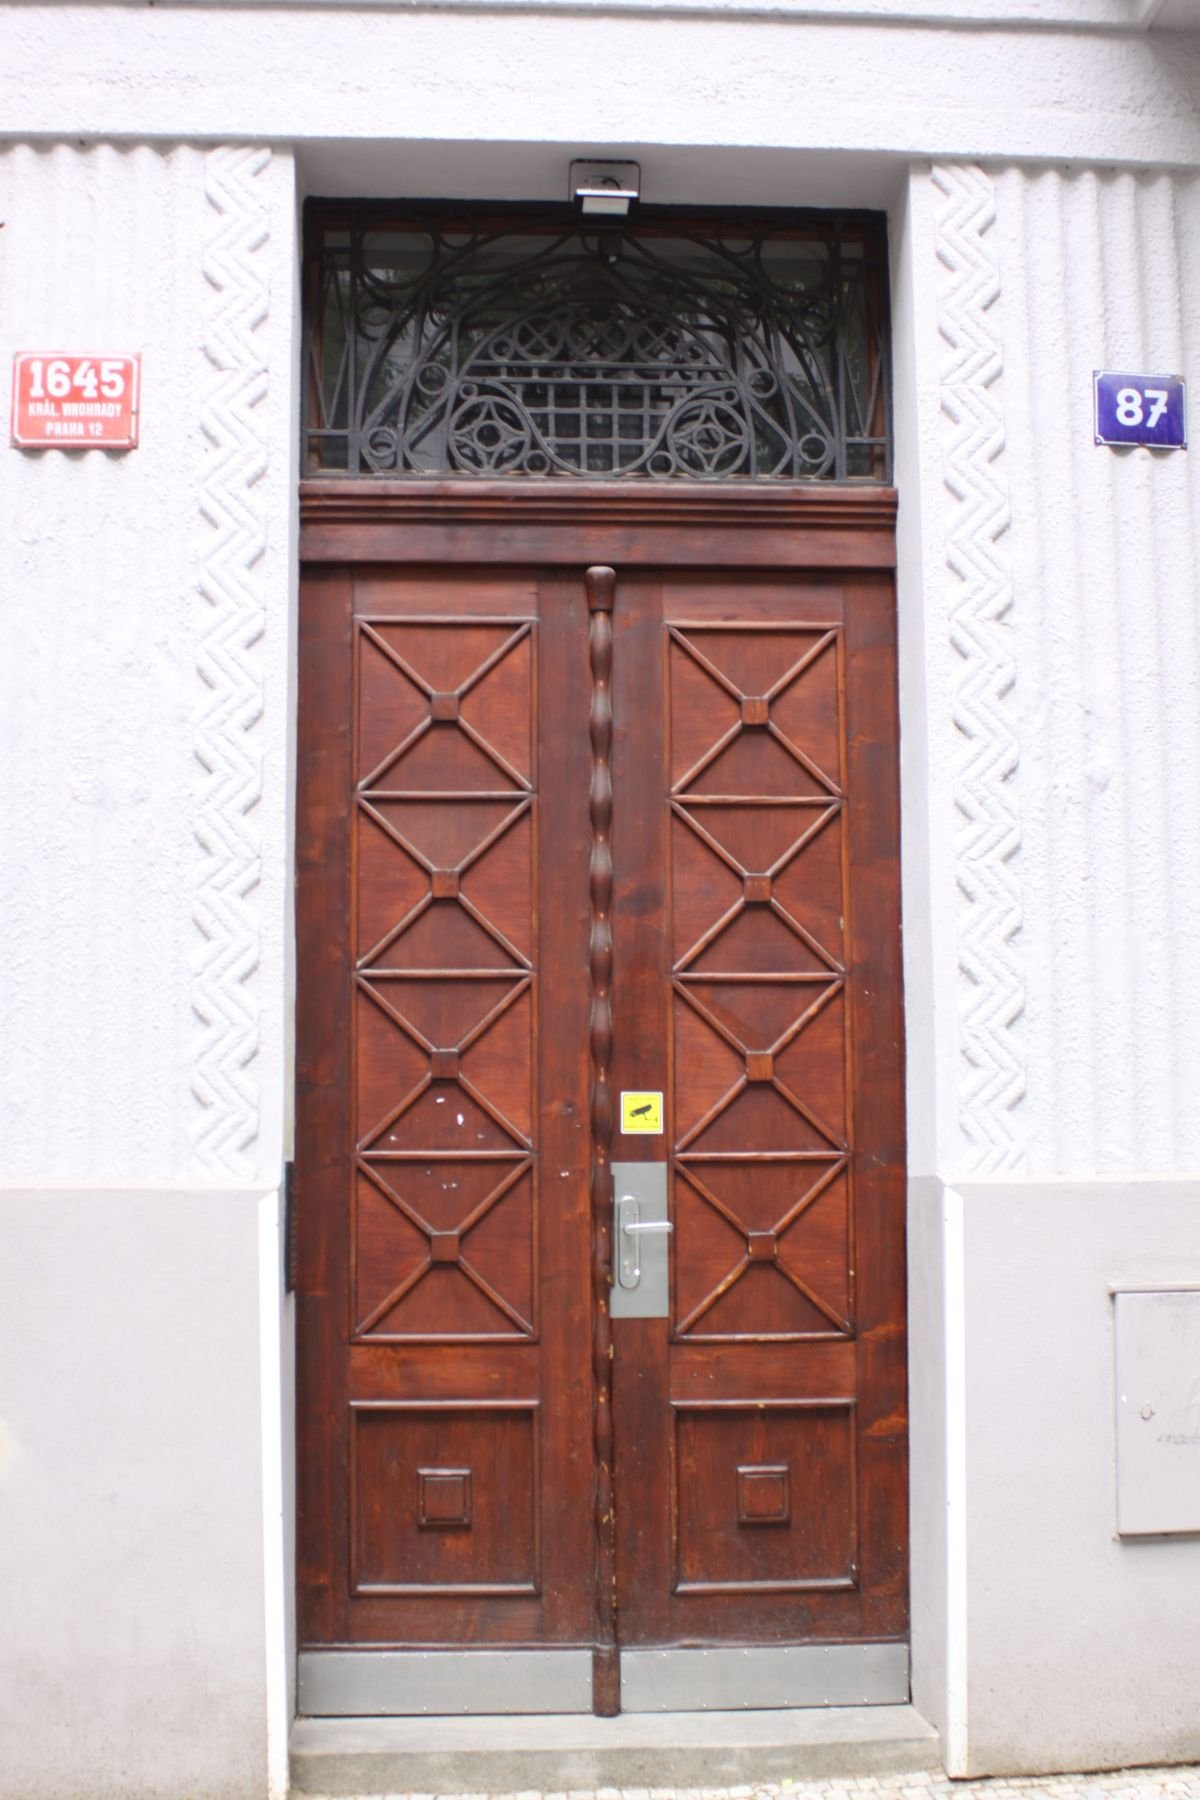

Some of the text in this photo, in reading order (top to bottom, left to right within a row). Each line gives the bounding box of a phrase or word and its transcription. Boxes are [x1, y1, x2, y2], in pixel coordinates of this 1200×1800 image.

[30, 361, 125, 398] 1645
[28, 400, 122, 417] KRÁL. VINOHRADY
[1116, 388, 1168, 428] 87
[45, 422, 103, 436] PRAHA 12
